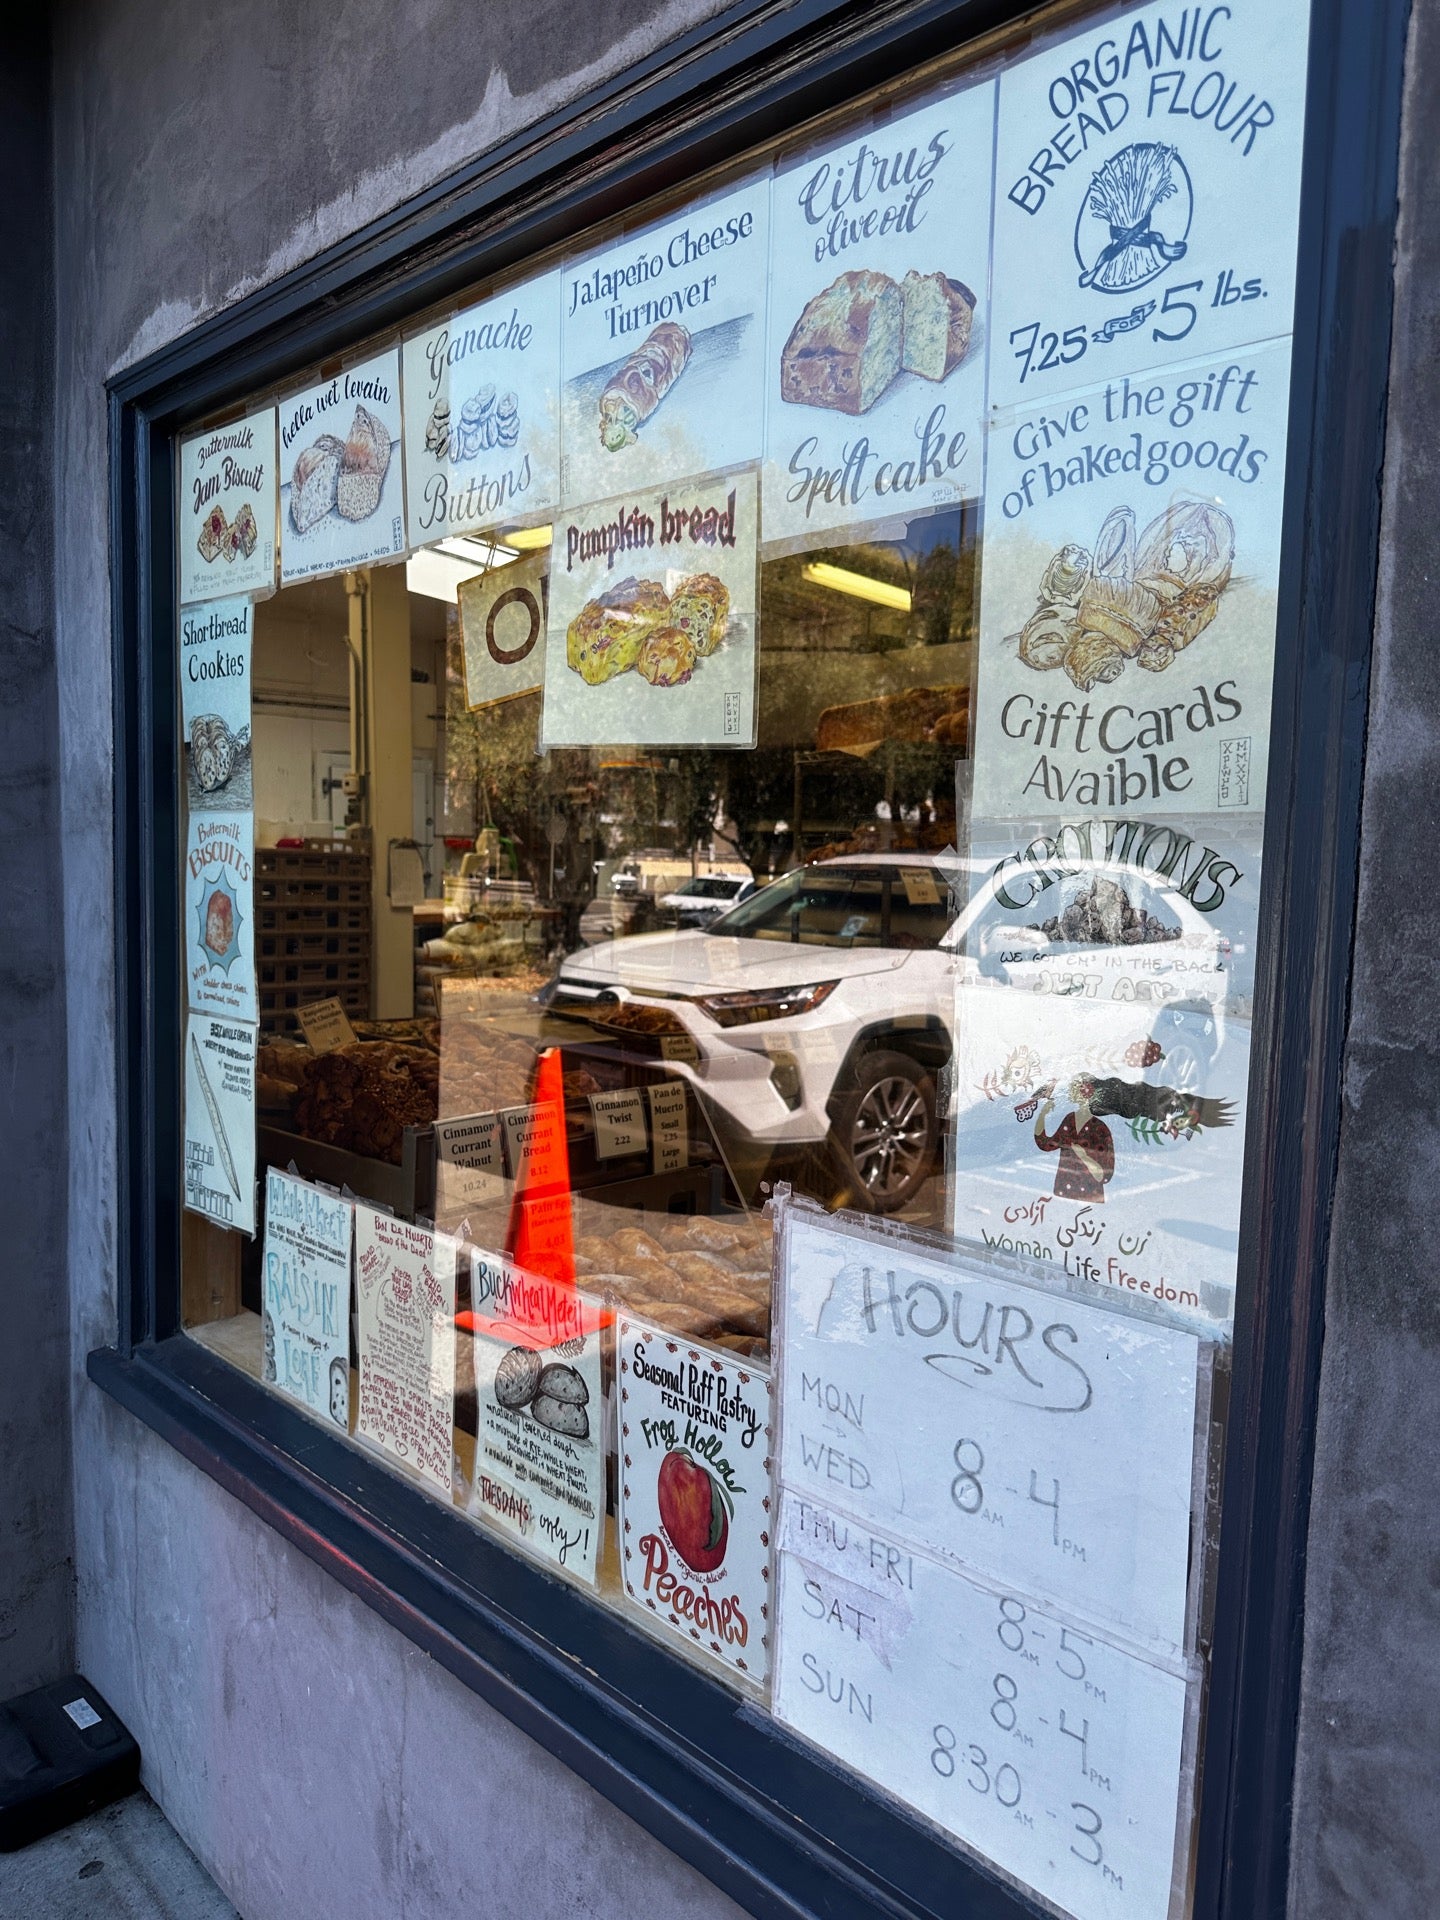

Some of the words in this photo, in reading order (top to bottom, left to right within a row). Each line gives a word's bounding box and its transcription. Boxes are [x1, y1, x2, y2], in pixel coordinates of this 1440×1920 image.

[1049, 6, 1231, 119] ORGANIC
[1008, 92, 1129, 216] BREAD
[1147, 70, 1275, 157] FLOUR
[798, 129, 954, 226] Citrus
[569, 253, 663, 318] Jalapeño
[668, 211, 753, 269] Cheese
[605, 274, 717, 339] Turnover
[1009, 321, 1088, 383] 7.25
[1109, 313, 1142, 331] FOR
[1152, 280, 1203, 342] 5
[1211, 269, 1269, 308] lbs.
[425, 308, 533, 400] Ganache
[317, 380, 341, 413] wet
[344, 374, 391, 405] levain
[1013, 404, 1089, 461] Give
[1103, 378, 1165, 424] the
[1169, 365, 1259, 428] gift
[197, 425, 254, 470] Buttermilk
[786, 436, 878, 519] Spelt
[875, 404, 969, 496] cake
[193, 473, 221, 515] Jam
[222, 455, 265, 492] Biscuit
[419, 453, 531, 530] Buttons
[1002, 468, 1041, 518] of
[1039, 434, 1142, 498] baked
[1144, 434, 1268, 486] goods
[660, 488, 736, 548] bread
[183, 607, 247, 646] Shortbread
[188, 650, 244, 682] Cookies
[1001, 692, 1090, 753] Gift
[1098, 679, 1242, 753] Cards
[1022, 752, 1193, 807] Avaible
[197, 822, 241, 843] Buttermilk
[993, 819, 1244, 912] CROUTONS
[1000, 952, 1023, 963] WE
[1105, 956, 1122, 968] IN
[1127, 958, 1161, 969] THE
[1172, 961, 1224, 974] BACK
[1033, 970, 1103, 996] JUST
[508, 1109, 557, 1127] Cinnamon
[595, 1097, 639, 1112] Cinnamon
[653, 1088, 669, 1100] Pan
[670, 1086, 681, 1097] de
[654, 1101, 684, 1115] Muerto
[443, 1121, 495, 1140] Cinnamon
[516, 1127, 553, 1143] Currant
[607, 1112, 632, 1125] Twist
[615, 1135, 631, 1146] 2.22
[661, 1119, 679, 1131] Small
[451, 1138, 492, 1156] Currant
[455, 1154, 492, 1171] Walnut
[523, 1143, 551, 1158] Bread
[530, 1164, 548, 1177] 8.12
[662, 1147, 680, 1159] Large
[462, 1179, 487, 1192] 10.24
[1004, 1196, 1052, 1227] آزادی
[1056, 1205, 1107, 1248] زندگی
[981, 1228, 1053, 1260] Woman
[1063, 1250, 1101, 1283] Life
[1107, 1257, 1199, 1307] Freedom
[1118, 1230, 1152, 1256] زن
[860, 1266, 1092, 1414] HOURS
[633, 1342, 685, 1396] Seasonal
[688, 1362, 714, 1408] Puff
[716, 1375, 762, 1449] Pastry
[661, 1391, 727, 1433] FEATURING
[801, 1371, 865, 1430] MON
[641, 1417, 678, 1452] Frog
[684, 1419, 747, 1494] Hollow
[800, 1433, 875, 1491] WED
[794, 1501, 849, 1551] THU
[869, 1536, 914, 1590] FRI
[638, 1533, 749, 1648] Peaches
[801, 1580, 876, 1642] SAT
[800, 1652, 874, 1724] SUN
